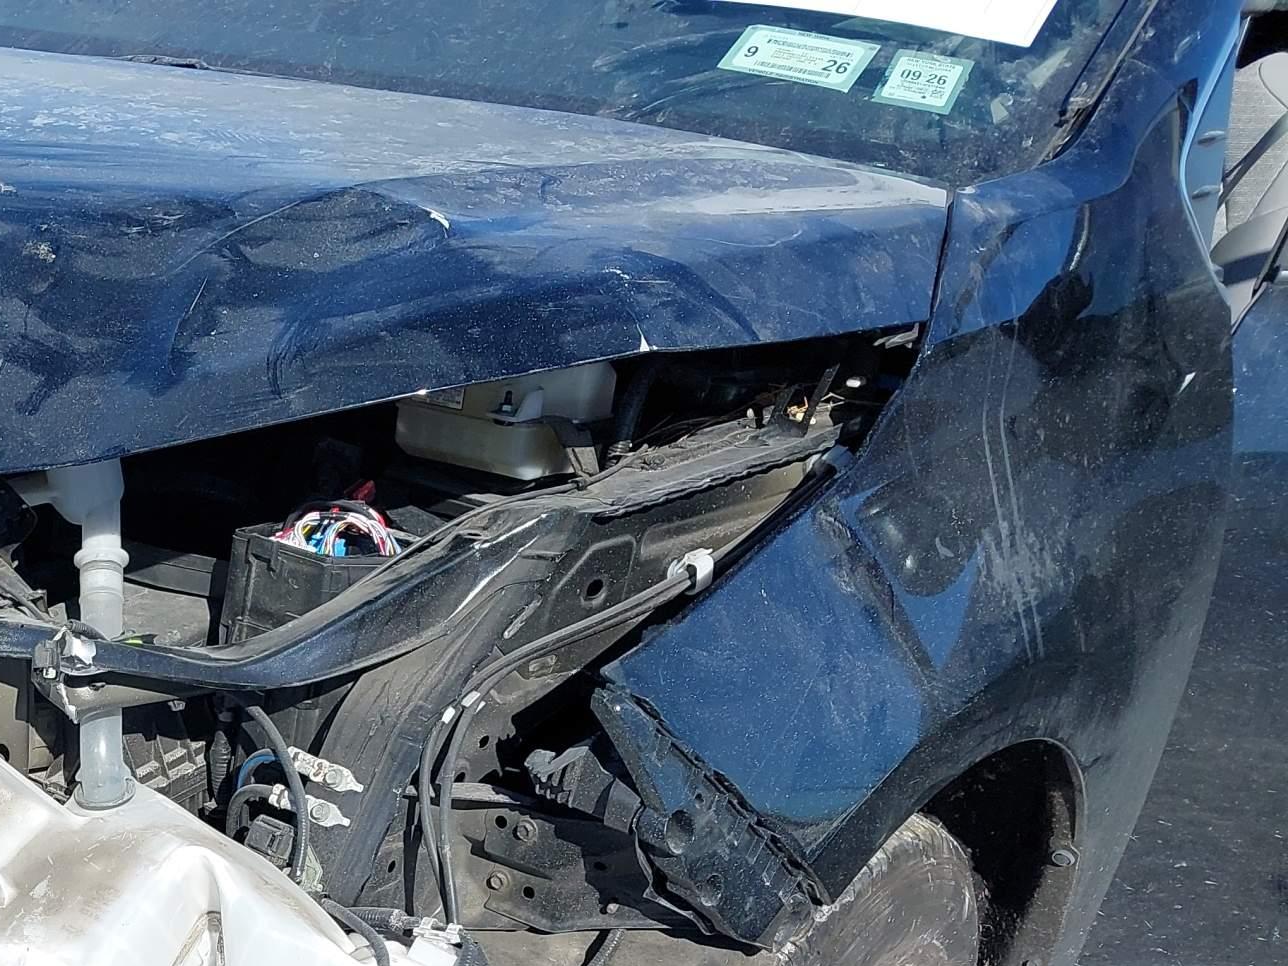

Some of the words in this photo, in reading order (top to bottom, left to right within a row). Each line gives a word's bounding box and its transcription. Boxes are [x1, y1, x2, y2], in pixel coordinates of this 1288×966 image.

[743, 45, 759, 58] 9
[821, 59, 851, 75] 26
[899, 68, 923, 81] 09
[925, 72, 949, 86] 26
